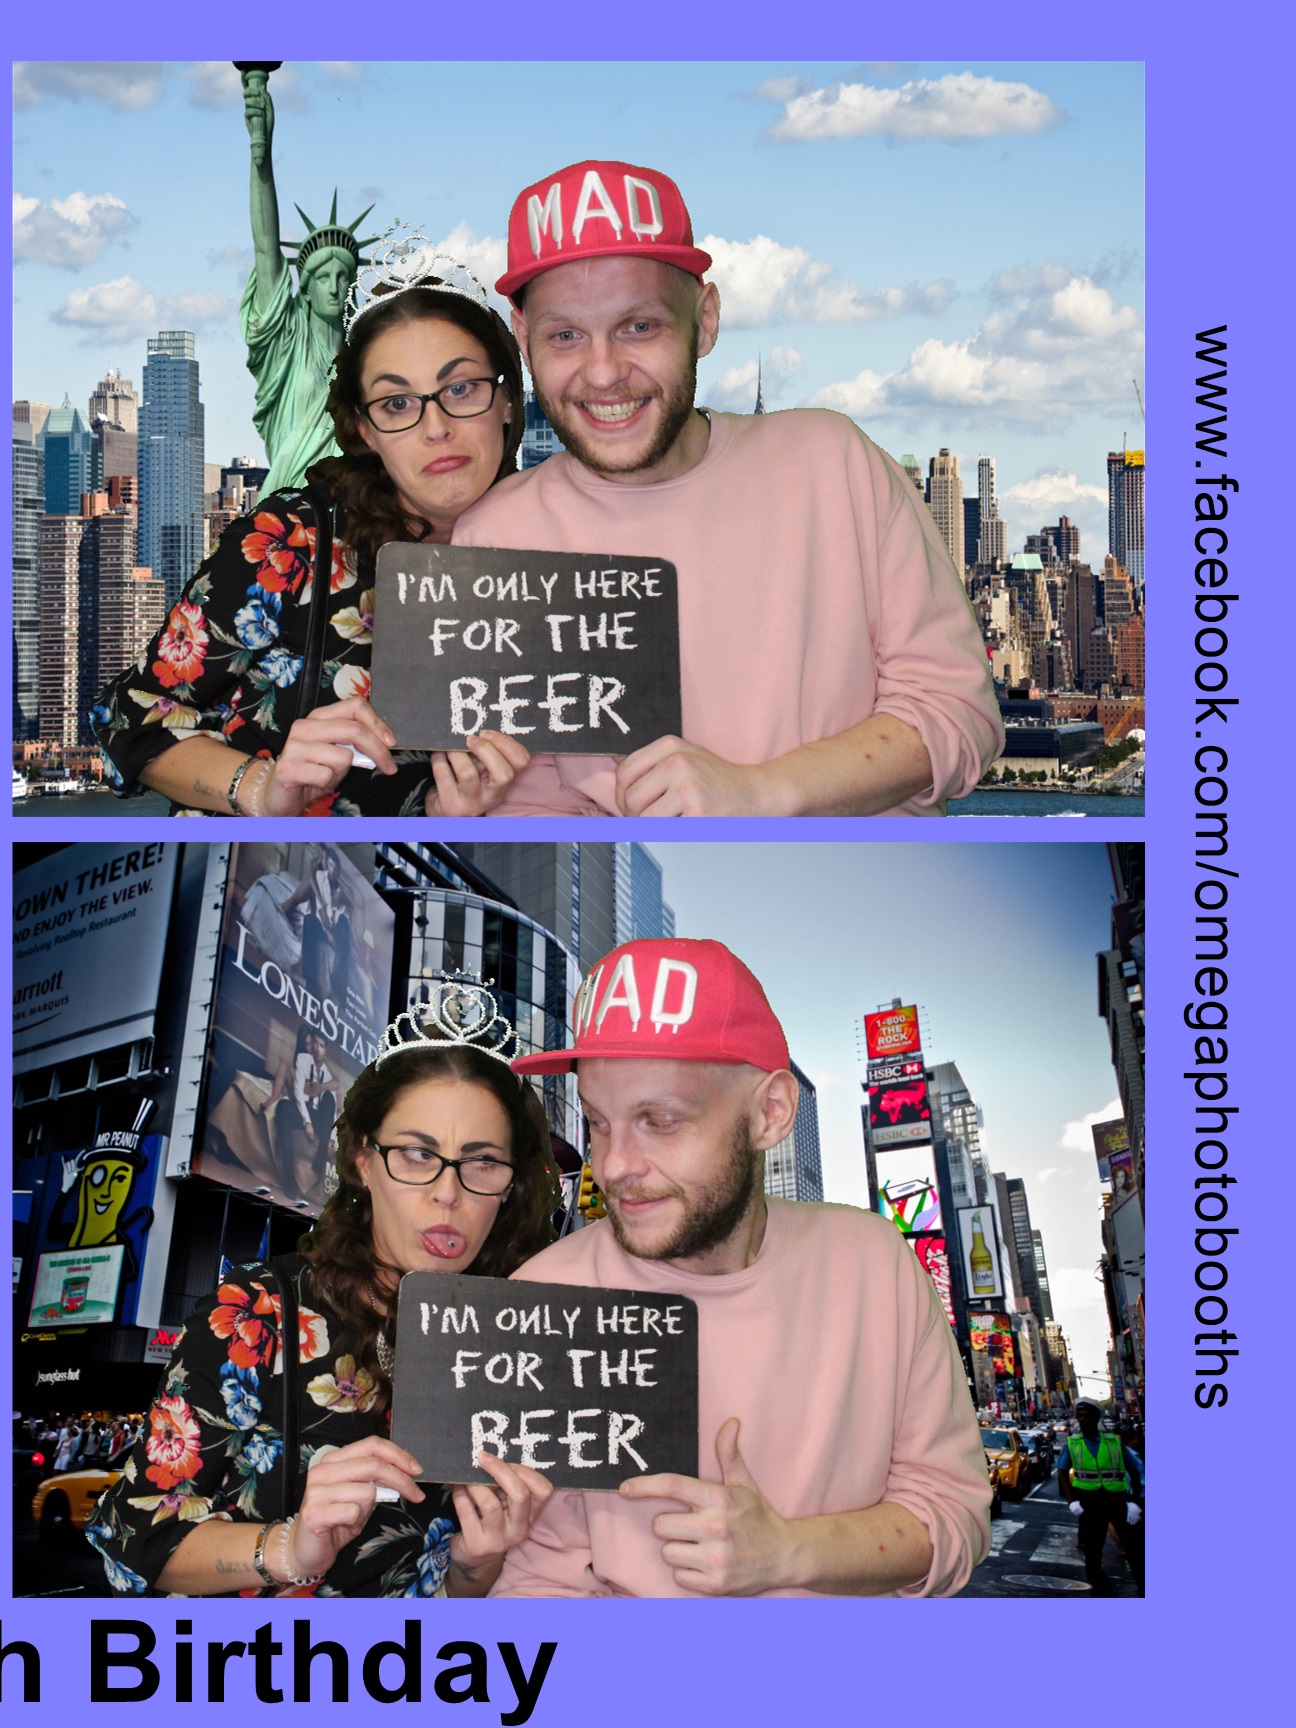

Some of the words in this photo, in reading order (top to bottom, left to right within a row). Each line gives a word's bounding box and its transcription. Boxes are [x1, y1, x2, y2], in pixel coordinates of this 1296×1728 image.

[527, 171, 664, 260] MAD
[397, 572, 458, 605] I'M
[472, 571, 558, 605] ONLY
[574, 568, 663, 600] HERE
[428, 616, 523, 657] FOR
[544, 611, 638, 653] THE
[449, 672, 631, 736] BEER
[13, 881, 68, 922] OWN
[75, 842, 165, 895] THERE!
[13, 927, 30, 945] ND
[33, 908, 77, 936] ENJOY
[80, 896, 108, 918] THE
[15, 940, 52, 960] Revolving
[54, 927, 87, 946] Rooftop
[88, 908, 137, 932] Restaurant
[13, 970, 64, 1005] arriott
[29, 995, 70, 1016] MARQUIS
[574, 953, 699, 1040] MAD
[876, 1015, 906, 1028] 1-800
[877, 1032, 908, 1045] ROCK
[880, 1025, 903, 1036] THE
[868, 1065, 902, 1081] HSBC
[110, 1131, 140, 1150] PEANUT
[875, 1128, 909, 1141] HSBC
[419, 1302, 480, 1335] I'M
[495, 1304, 581, 1339] ONLY
[597, 1305, 684, 1337] HERE
[67, 1367, 81, 1381] hut
[450, 1349, 545, 1392] FOR
[566, 1348, 658, 1388] THE
[470, 1408, 649, 1472] BEER
